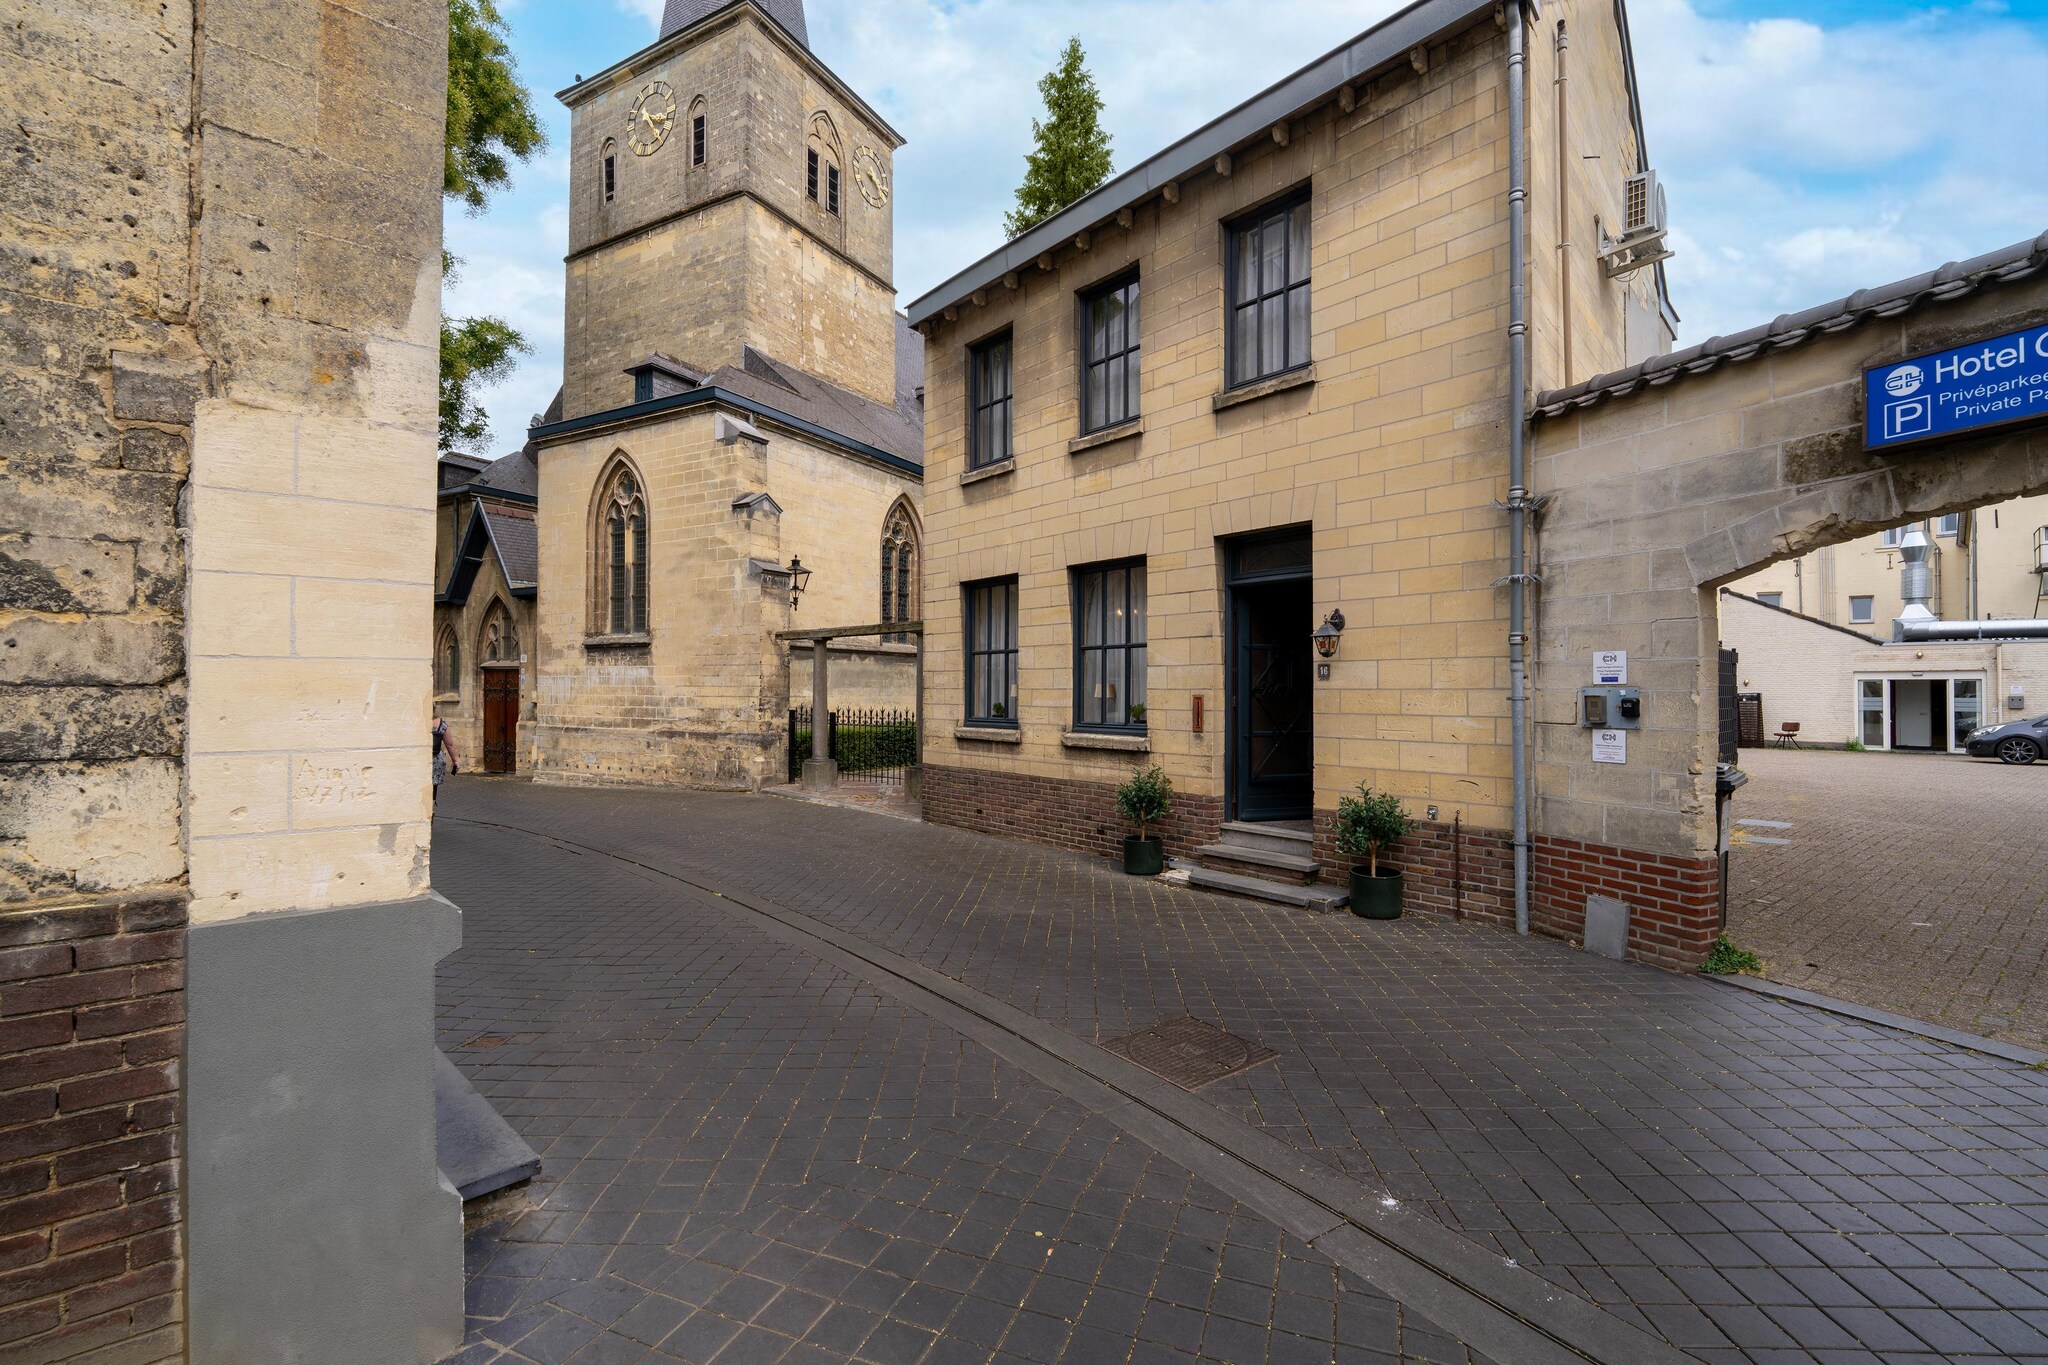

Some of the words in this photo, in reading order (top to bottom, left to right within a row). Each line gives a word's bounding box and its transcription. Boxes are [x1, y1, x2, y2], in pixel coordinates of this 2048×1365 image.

[1936, 337, 2025, 384] Hotel
[1895, 402, 1923, 433] P
[1955, 396, 2022, 419] Private
[1319, 666, 1329, 675] 16
